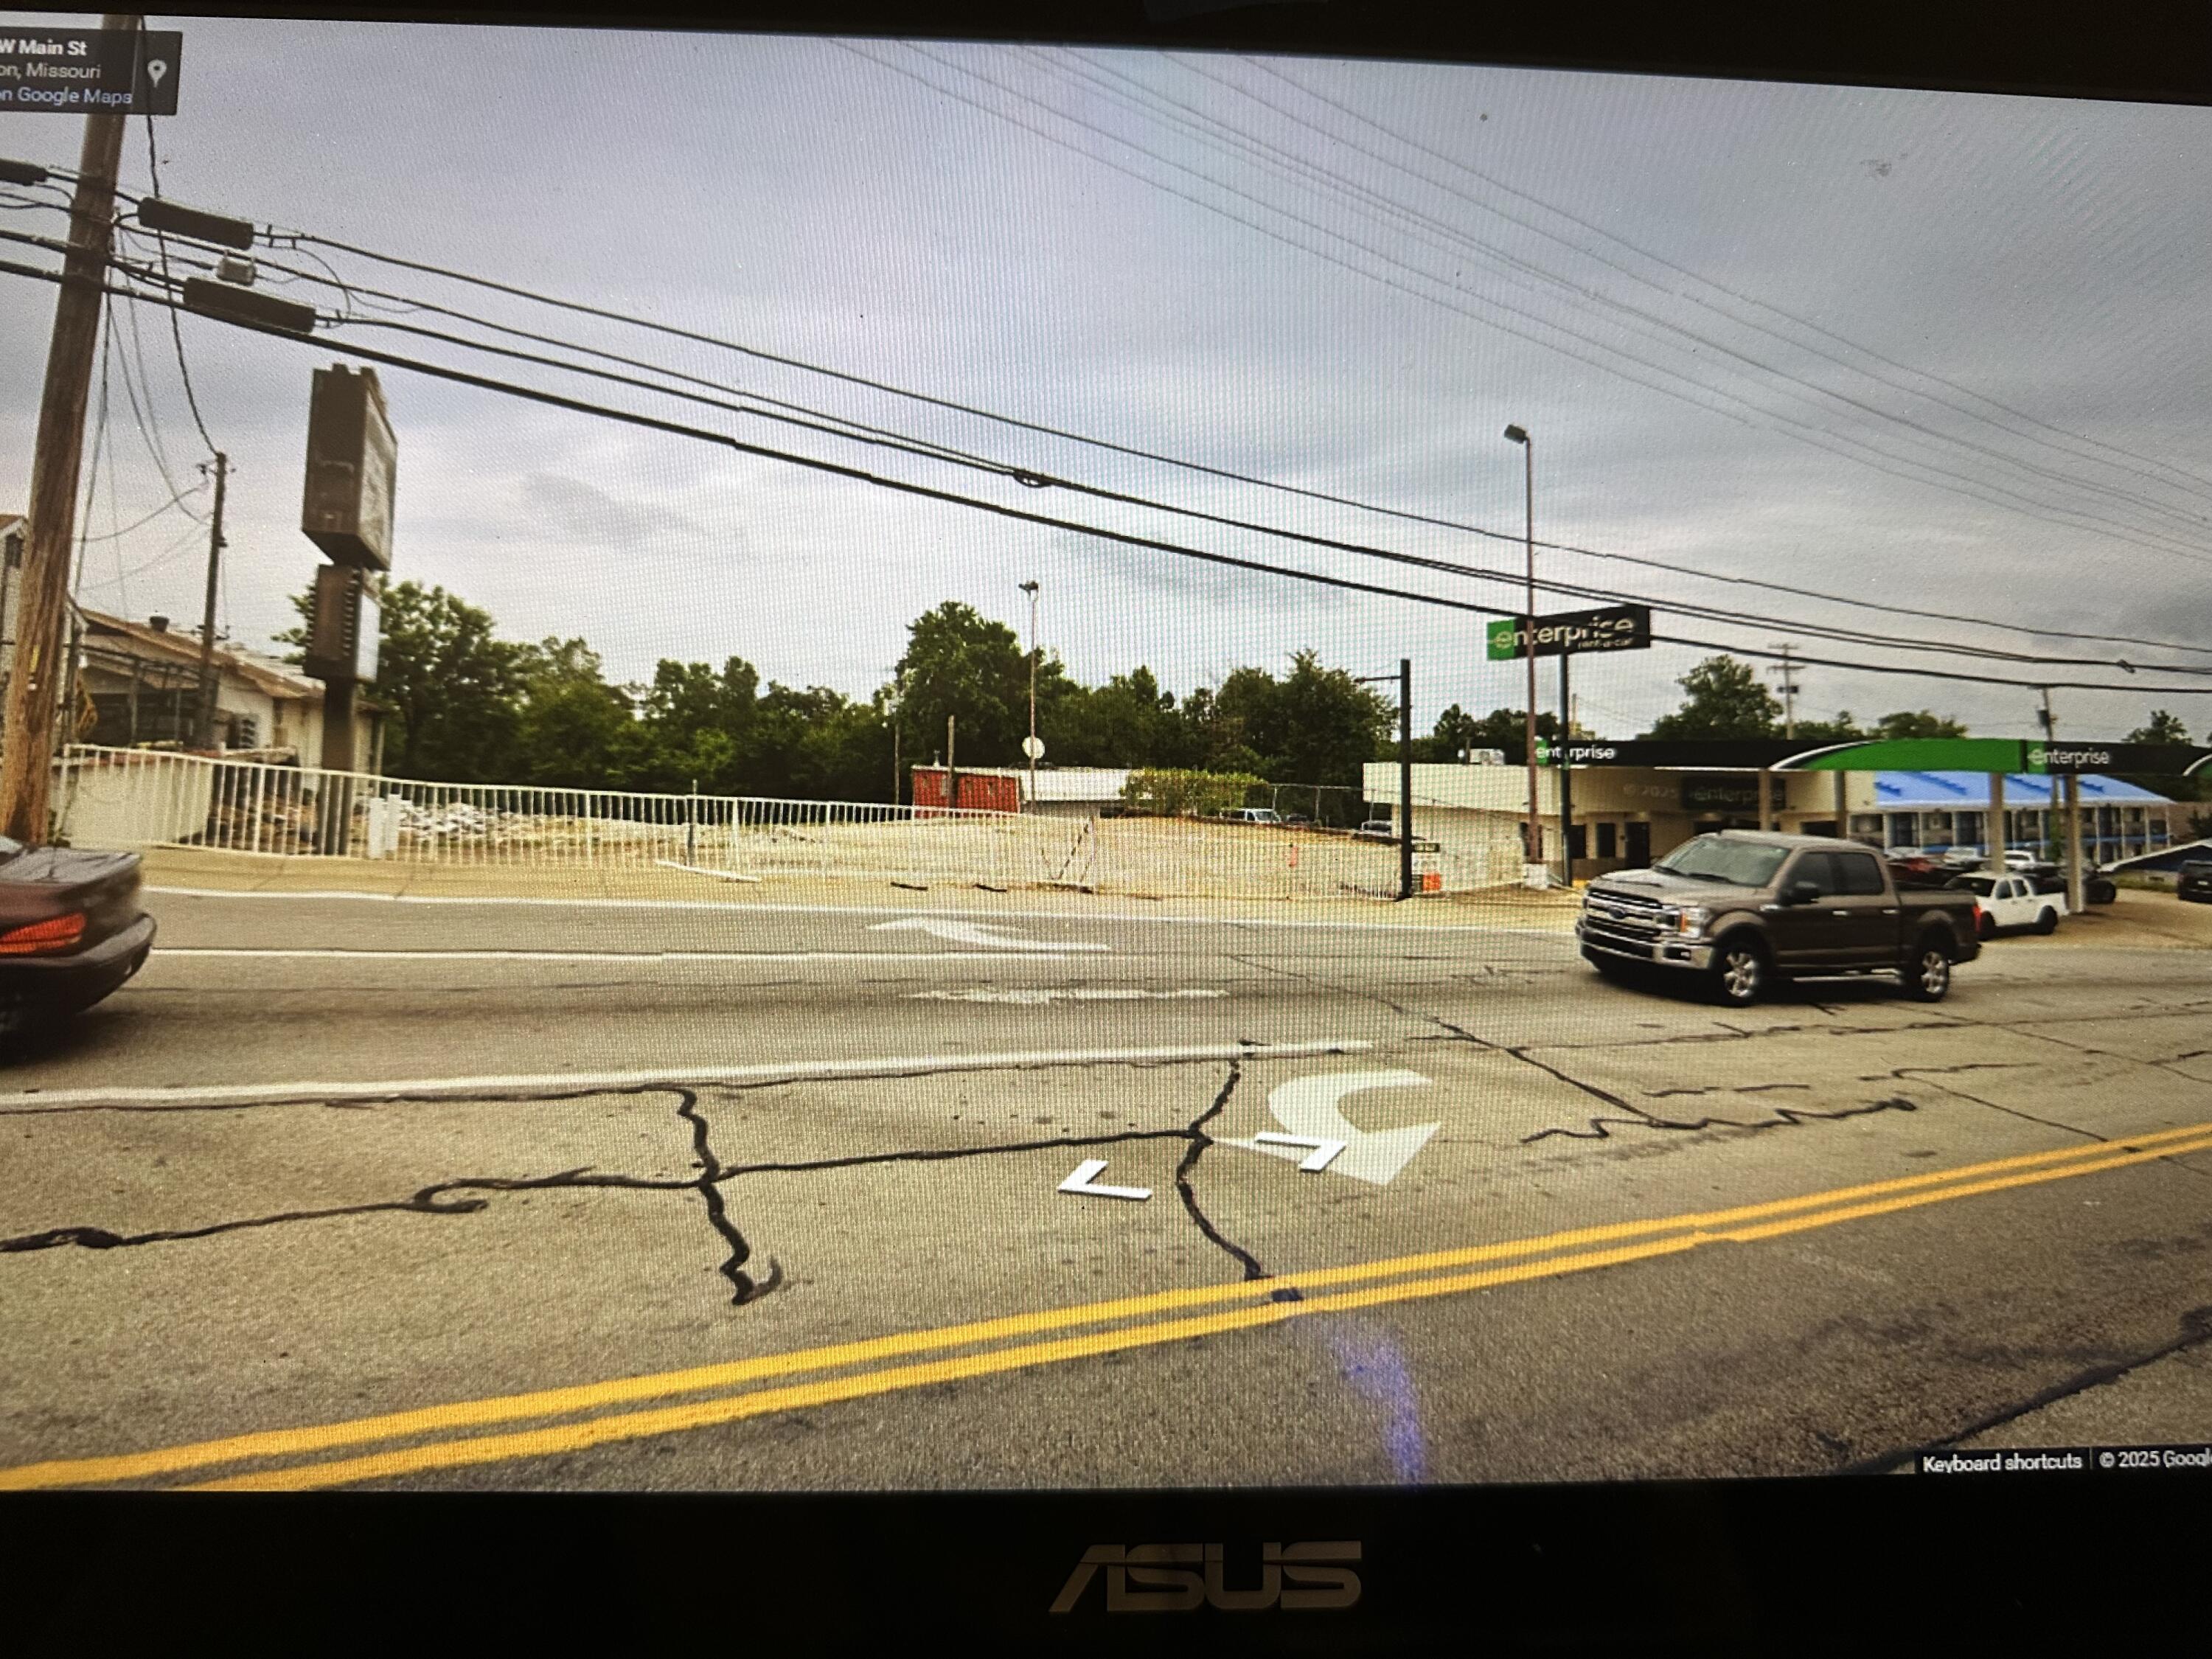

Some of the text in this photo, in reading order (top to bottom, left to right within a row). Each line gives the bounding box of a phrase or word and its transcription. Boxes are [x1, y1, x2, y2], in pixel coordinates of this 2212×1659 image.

[0, 38, 87, 56] W Main St
[27, 62, 100, 79] Missouri
[0, 86, 133, 106] n Google Maps
[1489, 616, 1634, 649] enerprise
[1534, 744, 1616, 761] entrprise
[2028, 747, 2110, 768] enterprise
[1923, 1453, 2082, 1473] Keyboard shortcuts
[2099, 1451, 2115, 1468] ©
[2118, 1450, 2160, 1467] 2025
[1048, 1540, 1362, 1613] ASUS
